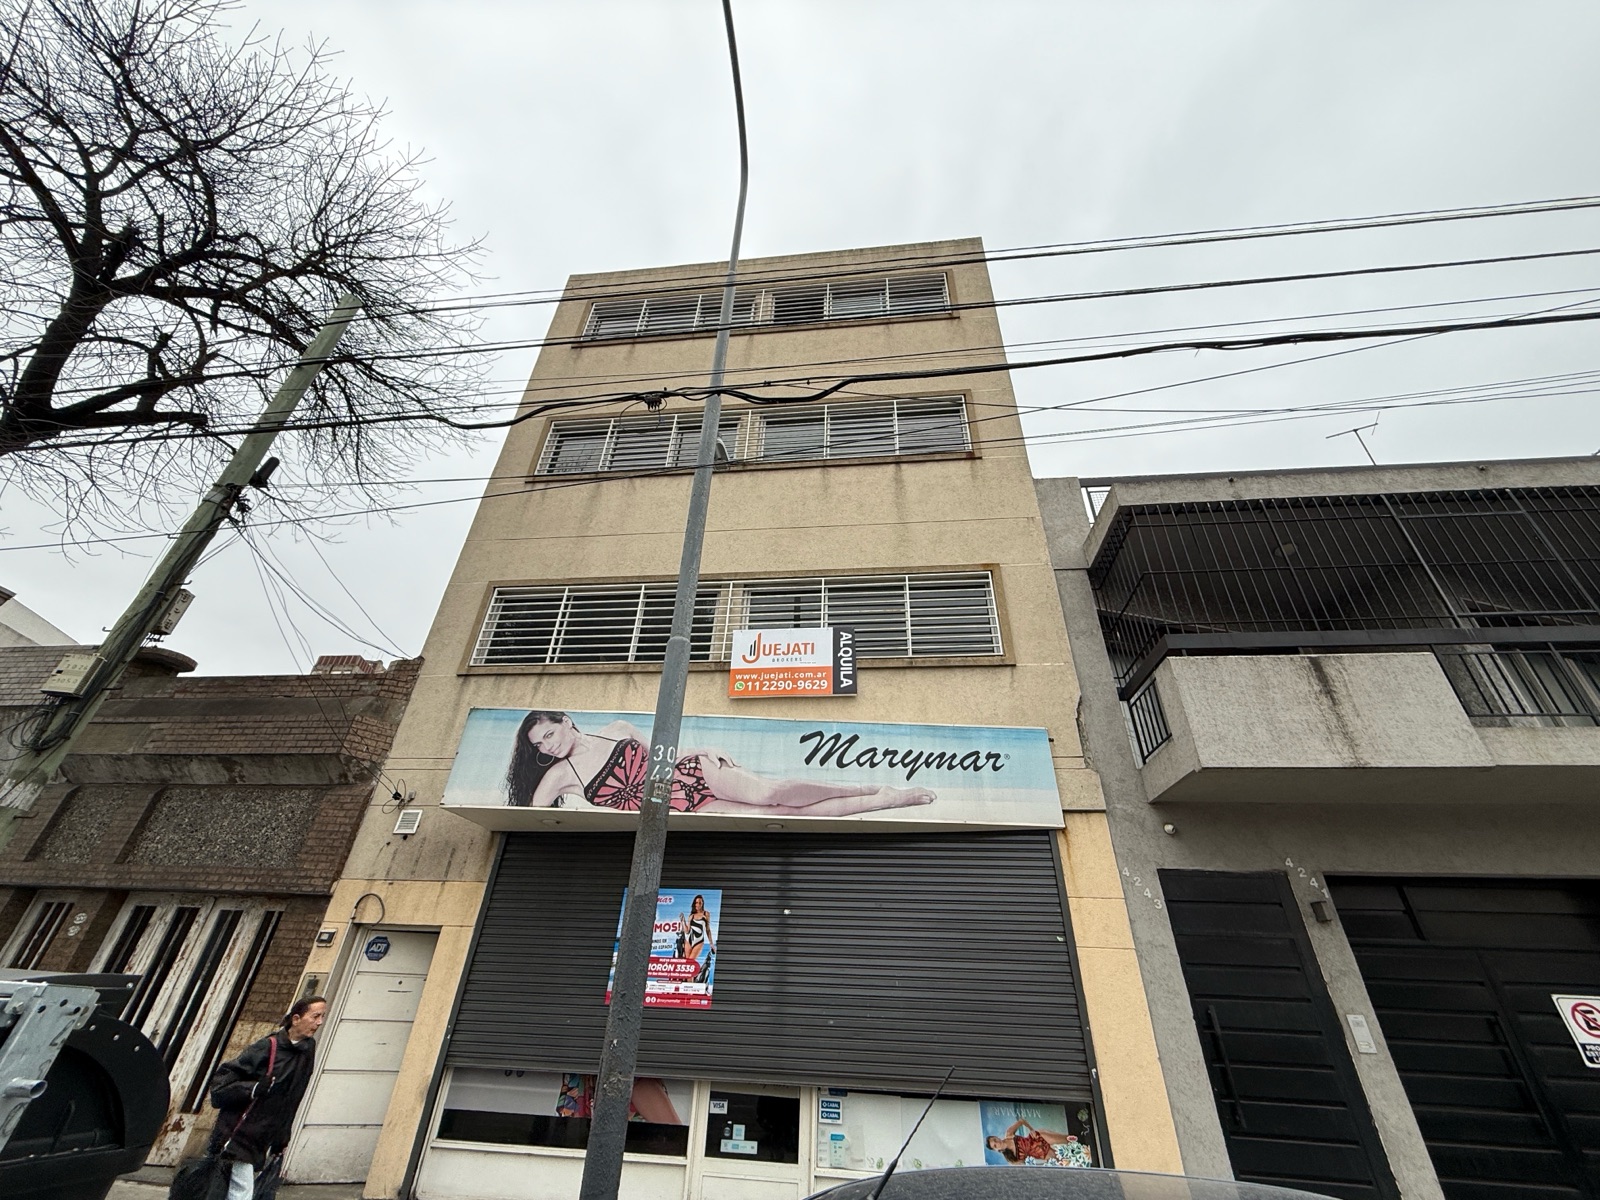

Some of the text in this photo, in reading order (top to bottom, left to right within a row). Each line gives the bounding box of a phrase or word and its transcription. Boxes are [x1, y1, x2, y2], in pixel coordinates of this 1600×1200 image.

[742, 632, 815, 664] JUEJATI
[837, 631, 853, 688] ALQUILA
[735, 671, 827, 681] www.juejati.com.ar
[653, 744, 676, 764] 30
[799, 730, 1005, 782] Marymar
[1122, 866, 1163, 910] 4243
[1285, 857, 1330, 899] 4241
[369, 943, 388, 953] ADT
